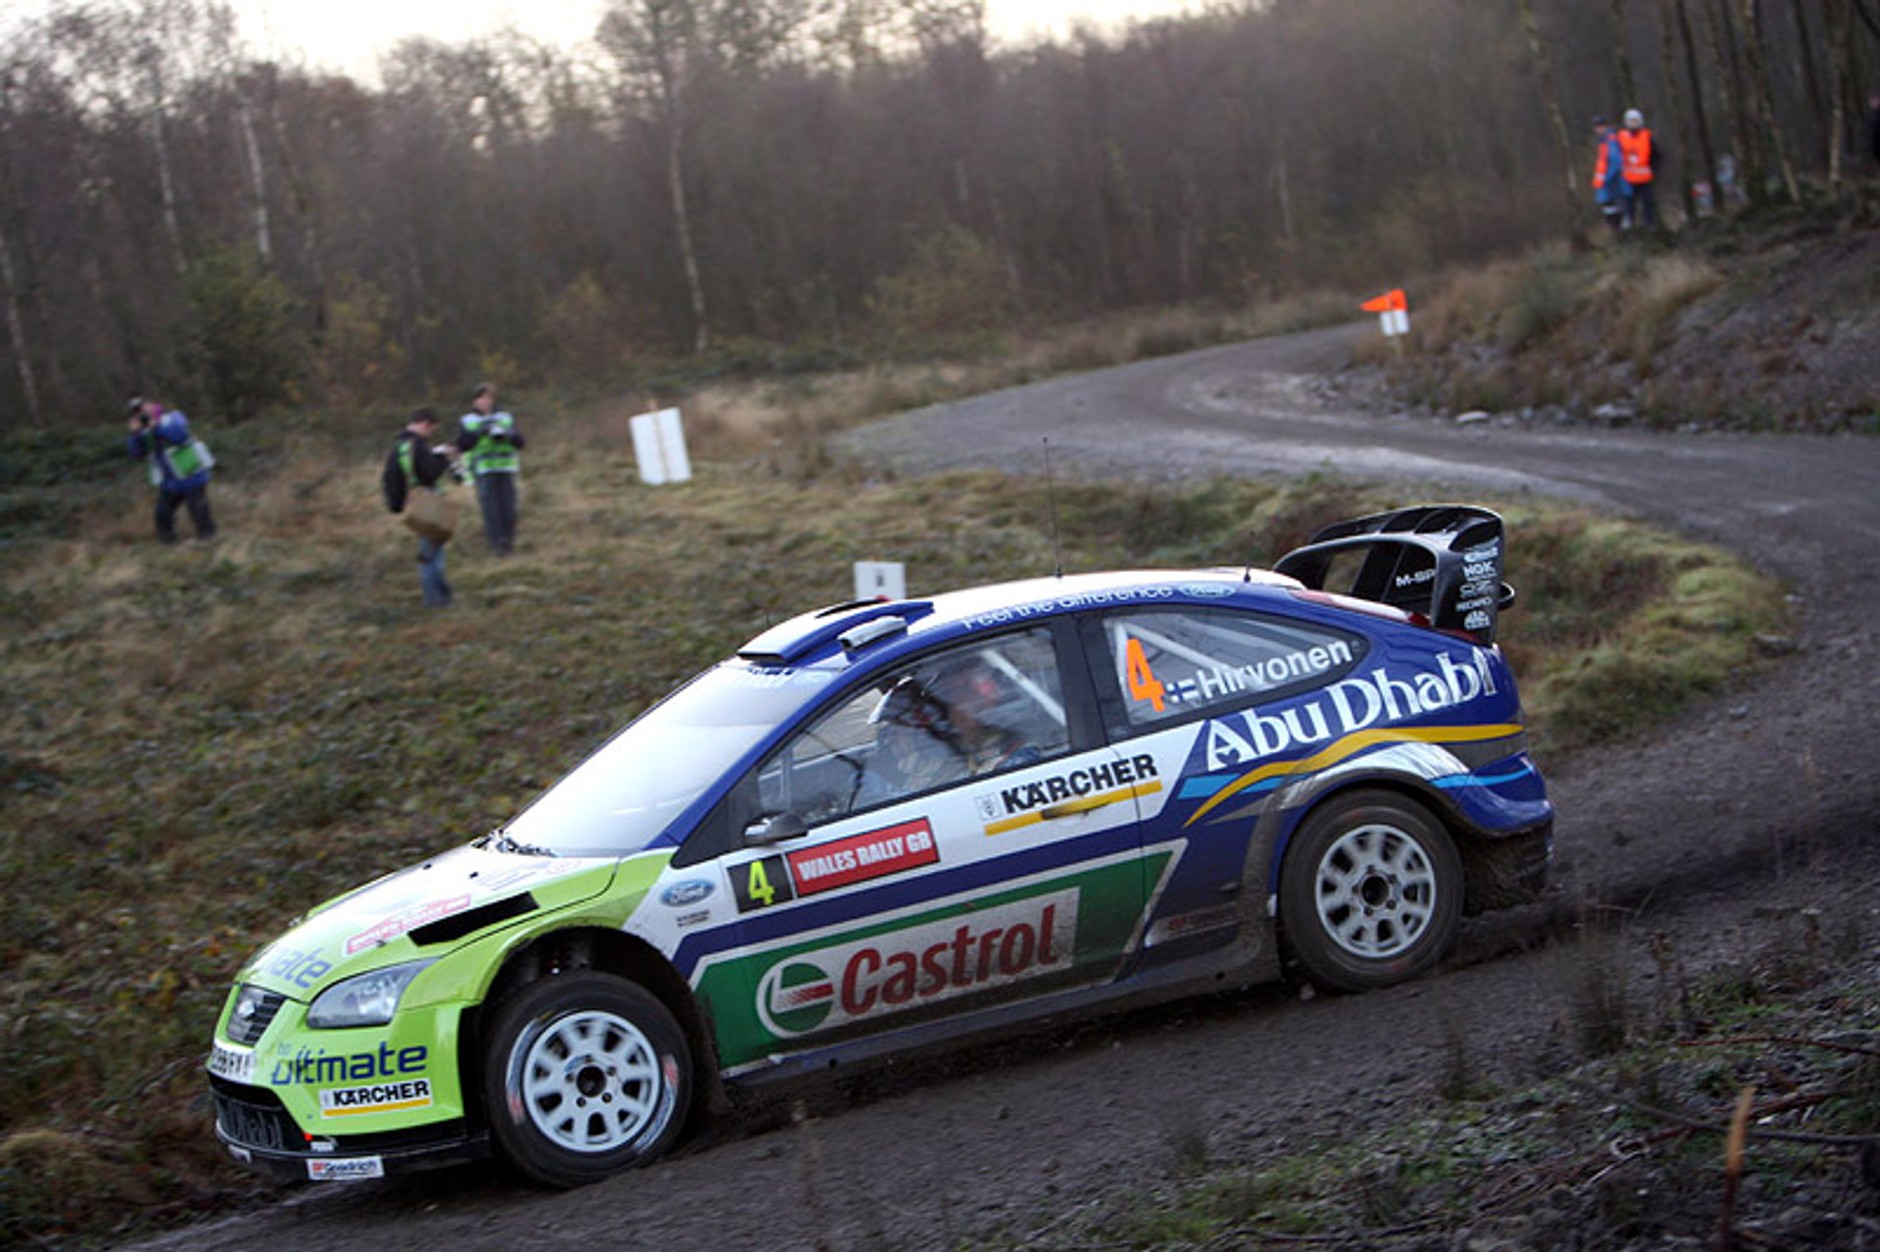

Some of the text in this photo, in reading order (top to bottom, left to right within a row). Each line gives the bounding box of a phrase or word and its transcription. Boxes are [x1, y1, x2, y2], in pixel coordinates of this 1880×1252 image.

[1125, 638, 1353, 713] 4 Hirvonen
[1207, 707, 1332, 772] Abu
[1001, 753, 1159, 815] KÄRCHER
[748, 859, 775, 906] 4
[797, 830, 932, 881] WALES RALLY GB
[840, 904, 1058, 1015] Castrol
[270, 1040, 428, 1086] ultimate
